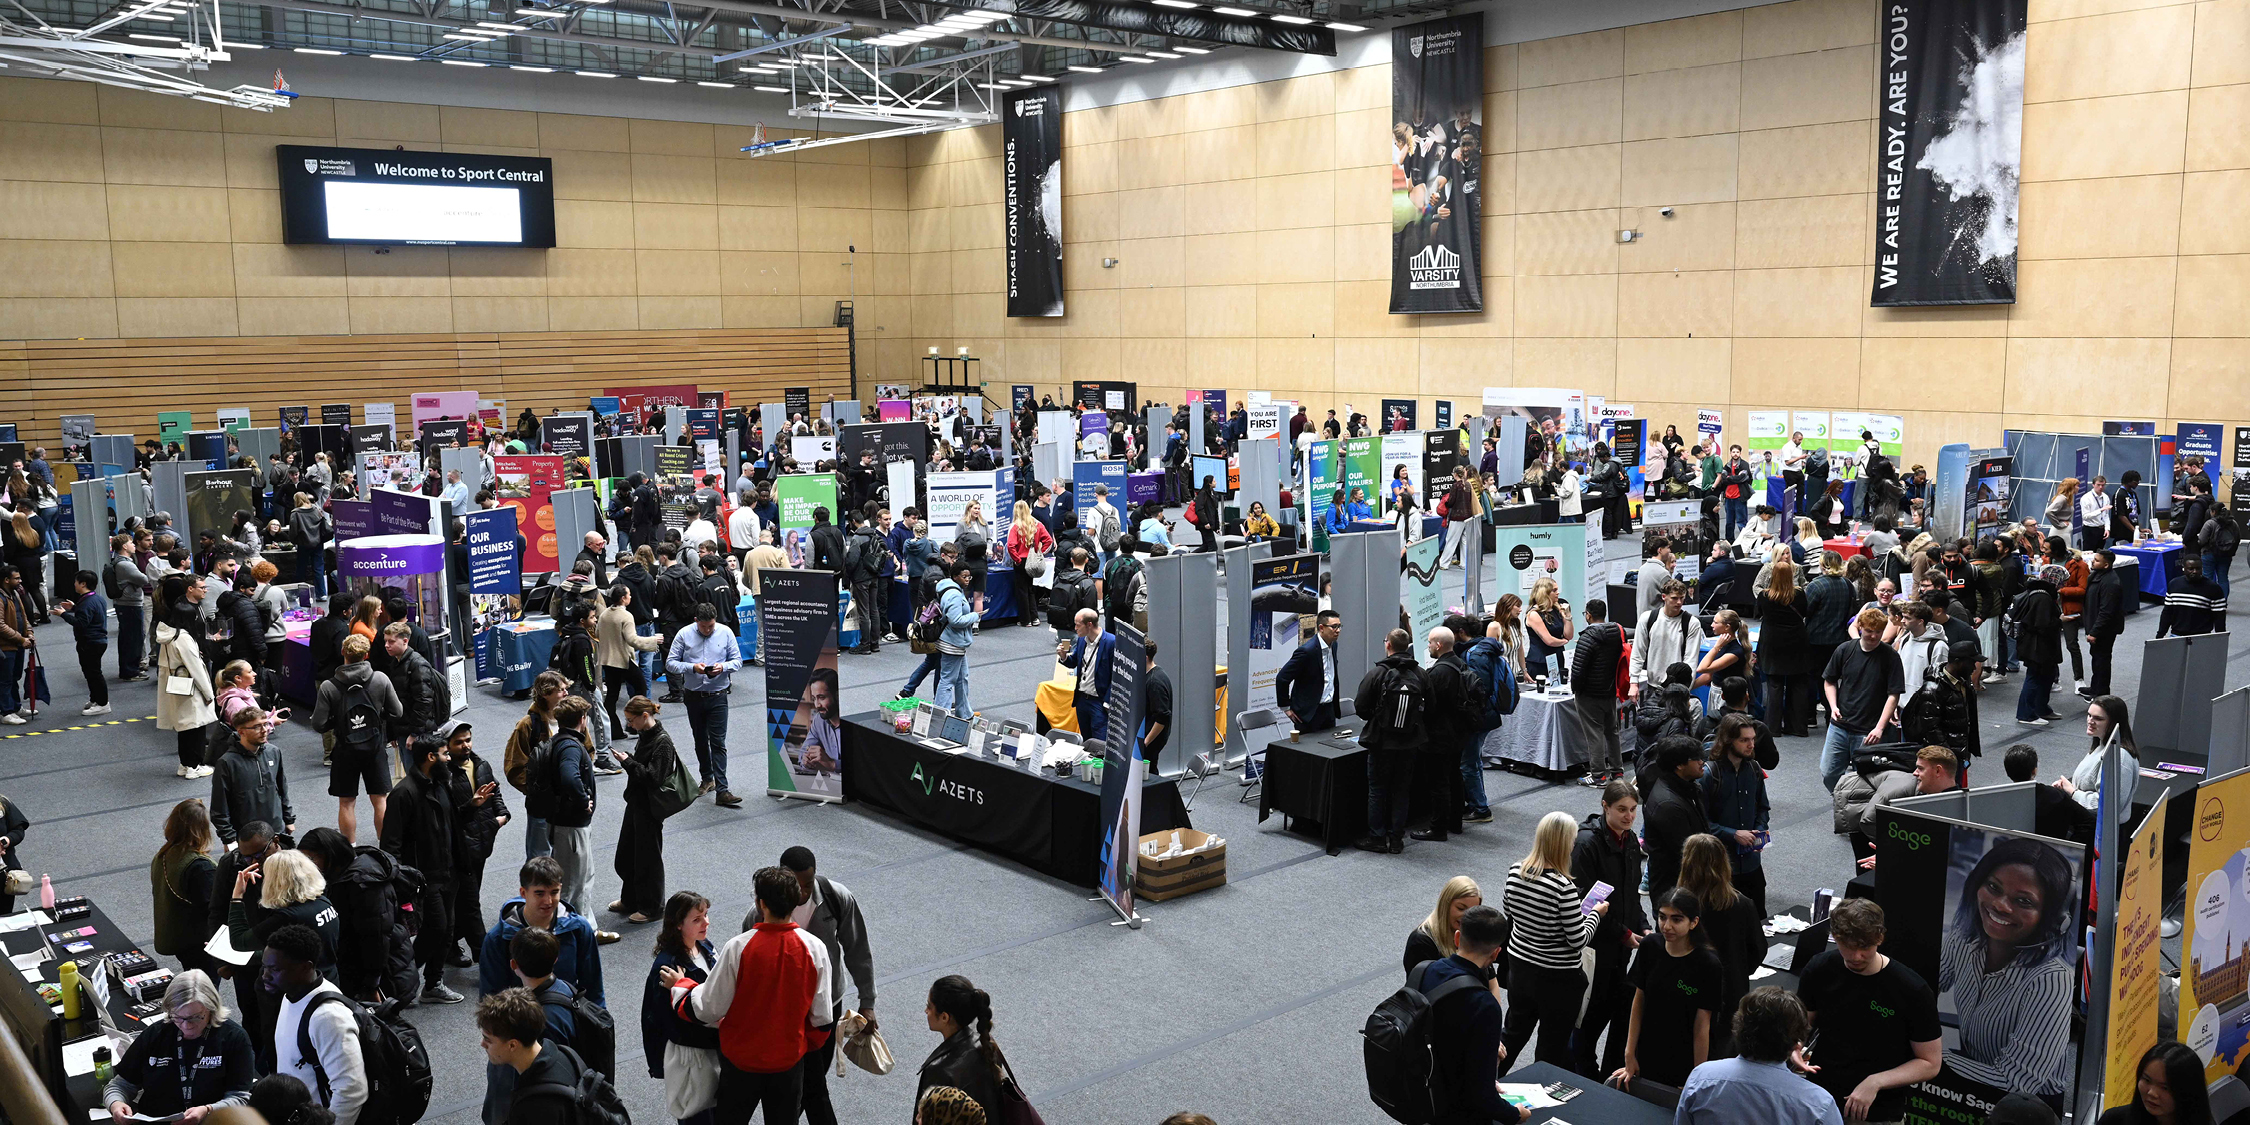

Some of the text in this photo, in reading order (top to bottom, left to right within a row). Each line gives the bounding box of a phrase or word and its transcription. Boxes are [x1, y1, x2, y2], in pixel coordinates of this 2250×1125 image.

[1426, 30, 1462, 42] Northumbria
[1426, 39, 1455, 49] University
[1426, 47, 1456, 57] NEWCASTLE
[1880, 4, 1909, 289] WE ARE READY. ARE YOU?
[320, 158, 351, 166] Northumbria
[375, 163, 544, 182] Welcome to Sport Central
[1007, 138, 1017, 247] CONVENTIONS.
[1410, 269, 1460, 281] VARSITY
[1601, 407, 1633, 418] dayone.
[1698, 411, 1721, 423] dayone.
[1250, 419, 1278, 428] FIRST
[1312, 445, 1329, 455] NWG
[1349, 441, 1370, 451] NWG
[2178, 449, 2218, 457] Opportunities
[532, 460, 555, 468] Property
[1991, 465, 2003, 473] KIER
[1348, 472, 1363, 480] OUR
[1312, 482, 1336, 491] PURPOSE
[938, 494, 971, 502] WORLD
[972, 493, 985, 501] OF
[931, 502, 994, 512] OPPORTTY.
[470, 532, 490, 544] OUR
[1530, 531, 1552, 539] humly
[471, 540, 514, 556] BUSINESS
[353, 559, 407, 569] accenture
[778, 579, 800, 587] AZETS
[1252, 667, 1278, 677] Advanced
[1252, 677, 1276, 686] Frequenc
[352, 722, 367, 730] adidas
[939, 781, 984, 805] AZETS
[2201, 811, 2222, 824] CHANGE
[2209, 819, 2222, 827] WORLD
[1887, 821, 1932, 850] Sage
[2207, 894, 2220, 904] 406
[1677, 979, 1699, 995] Sage
[1870, 1000, 1896, 1018] Sage
[2202, 1023, 2209, 1034] 62
[1921, 1081, 1996, 1115] know Sag
[1911, 1096, 1938, 1113] the
[1940, 1106, 1974, 1123] root
